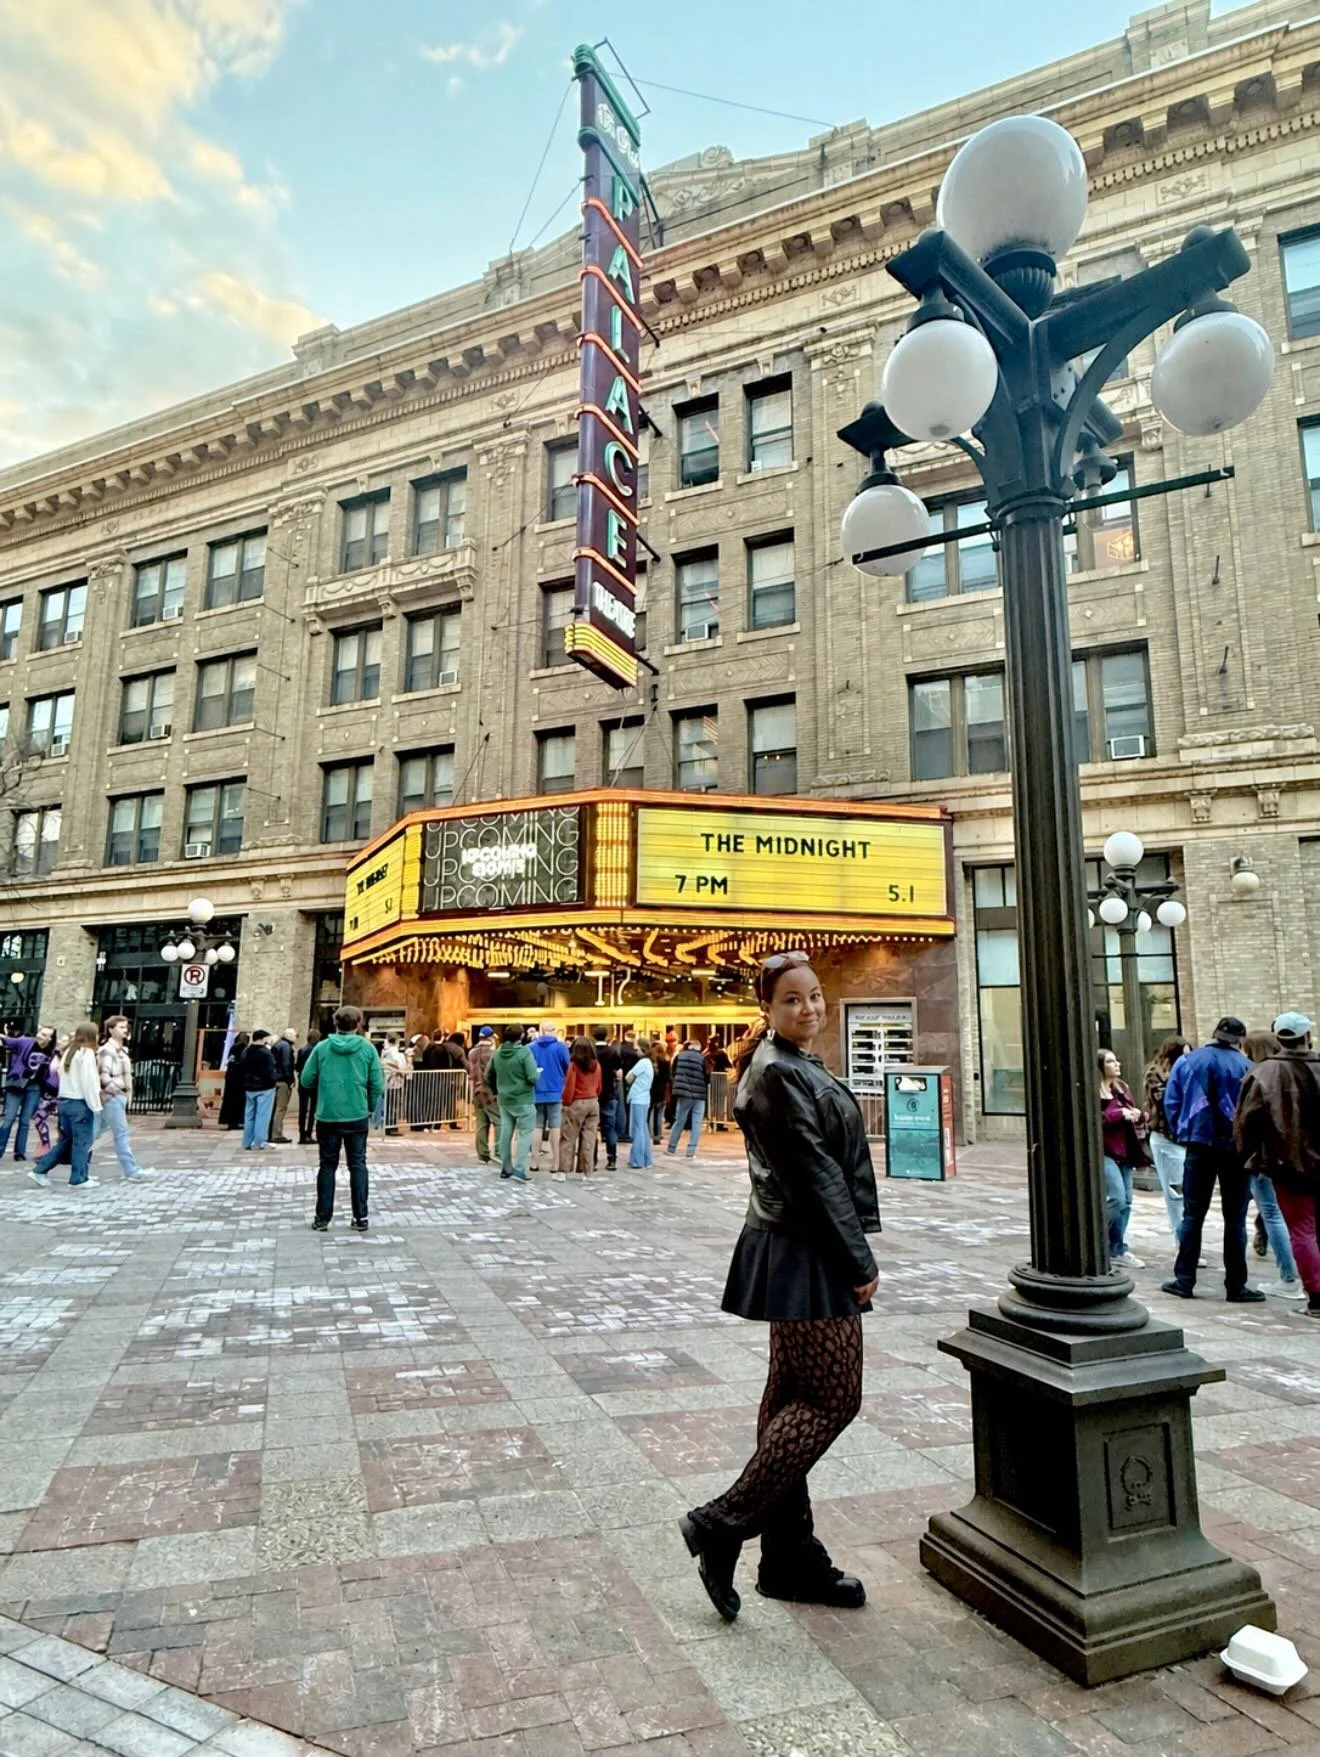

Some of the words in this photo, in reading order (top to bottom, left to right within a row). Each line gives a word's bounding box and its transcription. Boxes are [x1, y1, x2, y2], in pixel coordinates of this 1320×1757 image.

[604, 175, 636, 569] PALACE
[701, 832, 745, 853] THE
[756, 835, 871, 859] MIDNIGHT
[675, 875, 687, 893] 7
[696, 876, 728, 894] PM
[888, 885, 914, 903] 5.1
